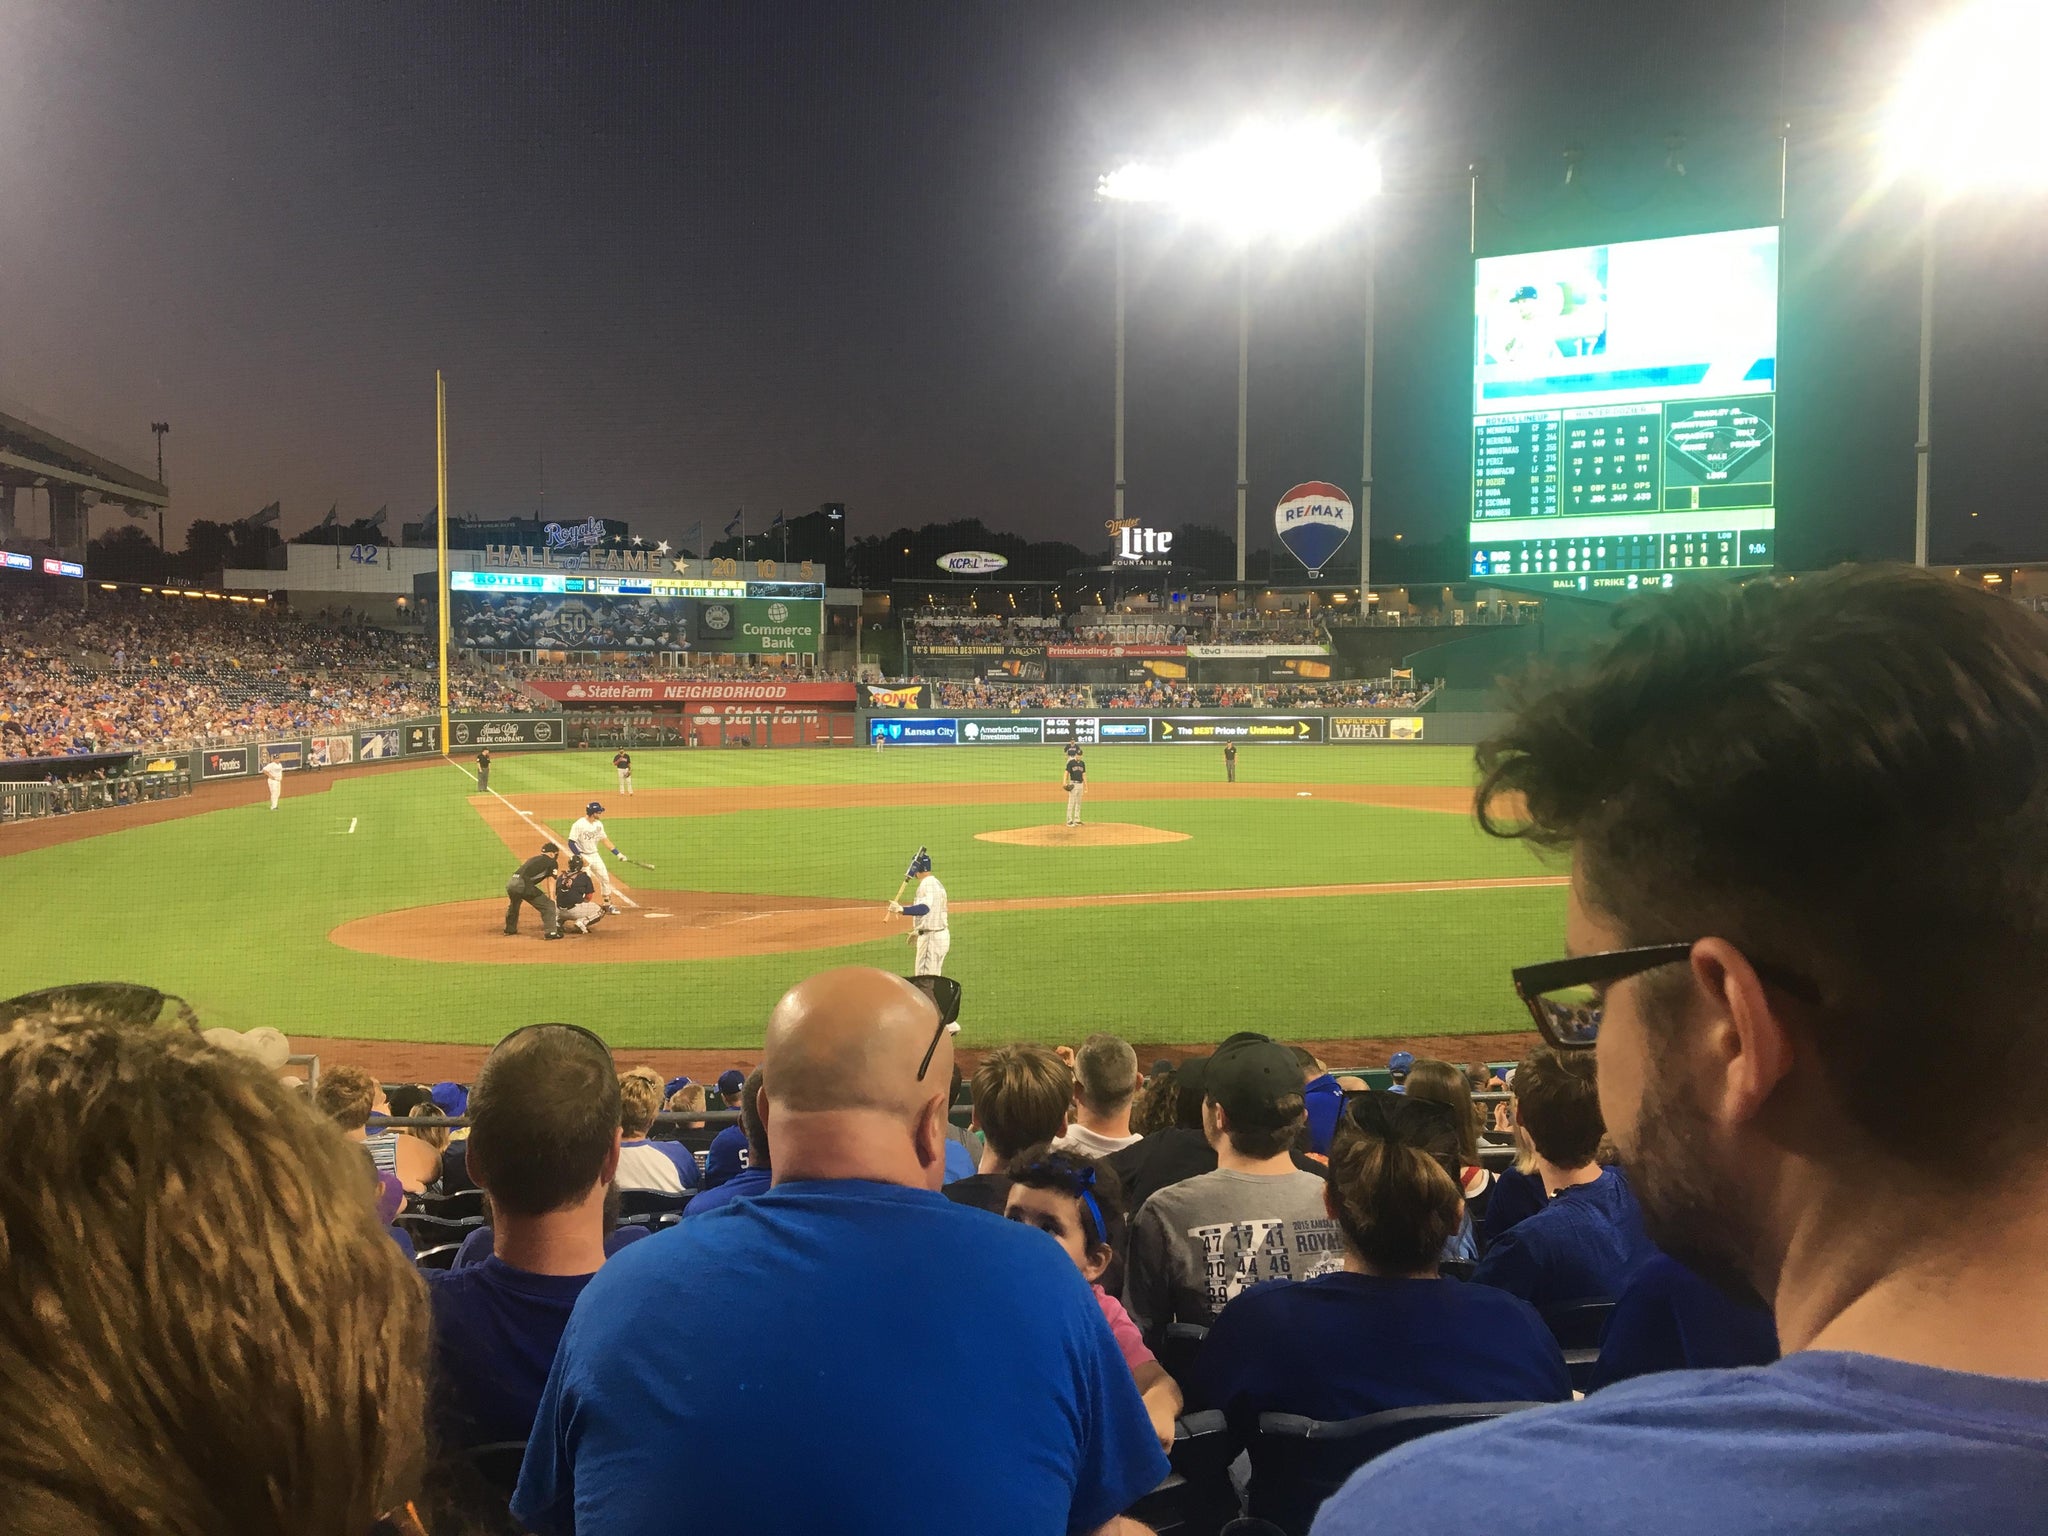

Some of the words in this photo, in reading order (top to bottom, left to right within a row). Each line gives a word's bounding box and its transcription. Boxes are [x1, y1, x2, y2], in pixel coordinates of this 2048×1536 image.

[1574, 338, 1598, 355] 17
[1640, 425, 1646, 433] H
[1614, 455, 1625, 463] HR
[1486, 478, 1506, 486] DOZIER
[1611, 483, 1627, 491] SLG
[1286, 504, 1343, 521] RE/MAX
[544, 516, 606, 550] Royals
[1105, 518, 1140, 537] Miller
[1119, 527, 1173, 560] Lite
[1684, 543, 1693, 554] 11
[1701, 542, 1707, 553] 1
[1721, 542, 1728, 552] 3
[1749, 544, 1766, 554] 9:06
[350, 544, 378, 564] 42
[486, 544, 559, 569] HALL
[563, 552, 589, 570] of
[589, 549, 662, 571] FAME
[712, 557, 736, 577] 20
[755, 559, 777, 579] 10
[800, 559, 813, 579] 5
[949, 558, 979, 568] KCP&L
[1535, 562, 1542, 572] 1
[1670, 557, 1676, 567] 1
[1684, 556, 1692, 566] 5
[1700, 556, 1708, 566] 0
[1720, 555, 1728, 565] 4
[1554, 580, 1575, 588] BALL
[1578, 576, 1587, 591] 1
[1594, 578, 1625, 587] STRIKE
[1627, 574, 1638, 590] 2
[1642, 577, 1661, 585] OUT
[1662, 573, 1673, 588] 2
[560, 613, 586, 633] 50
[742, 623, 812, 635] Commerce
[762, 637, 795, 648] Bank
[930, 646, 959, 655] WINNING
[1008, 647, 1041, 656] ARGOSY
[1049, 647, 1108, 656] PrimeLending
[1200, 647, 1221, 655] teva
[664, 686, 787, 698] NEIGHBORHOOD
[873, 692, 917, 705] SONIC
[937, 728, 955, 737] City
[1012, 726, 1039, 735] Century
[1178, 726, 1193, 735] The
[1193, 727, 1213, 735] BEST
[1215, 727, 1235, 735] Price
[1236, 727, 1248, 735] for
[1250, 726, 1294, 735] Unlimited
[1336, 724, 1386, 738] WHEAT
[494, 735, 524, 743] COMPANY
[219, 758, 240, 771] Fanatics
[1292, 1220, 1309, 1230] 2015
[1203, 1235, 1221, 1253] 47
[1234, 1231, 1253, 1249] 17
[1266, 1230, 1284, 1247] 41
[1296, 1232, 1344, 1252] ROYAL
[1206, 1261, 1225, 1278] 40
[1237, 1257, 1258, 1275] 44
[1270, 1255, 1290, 1273] 46
[1207, 1287, 1228, 1304] 39
